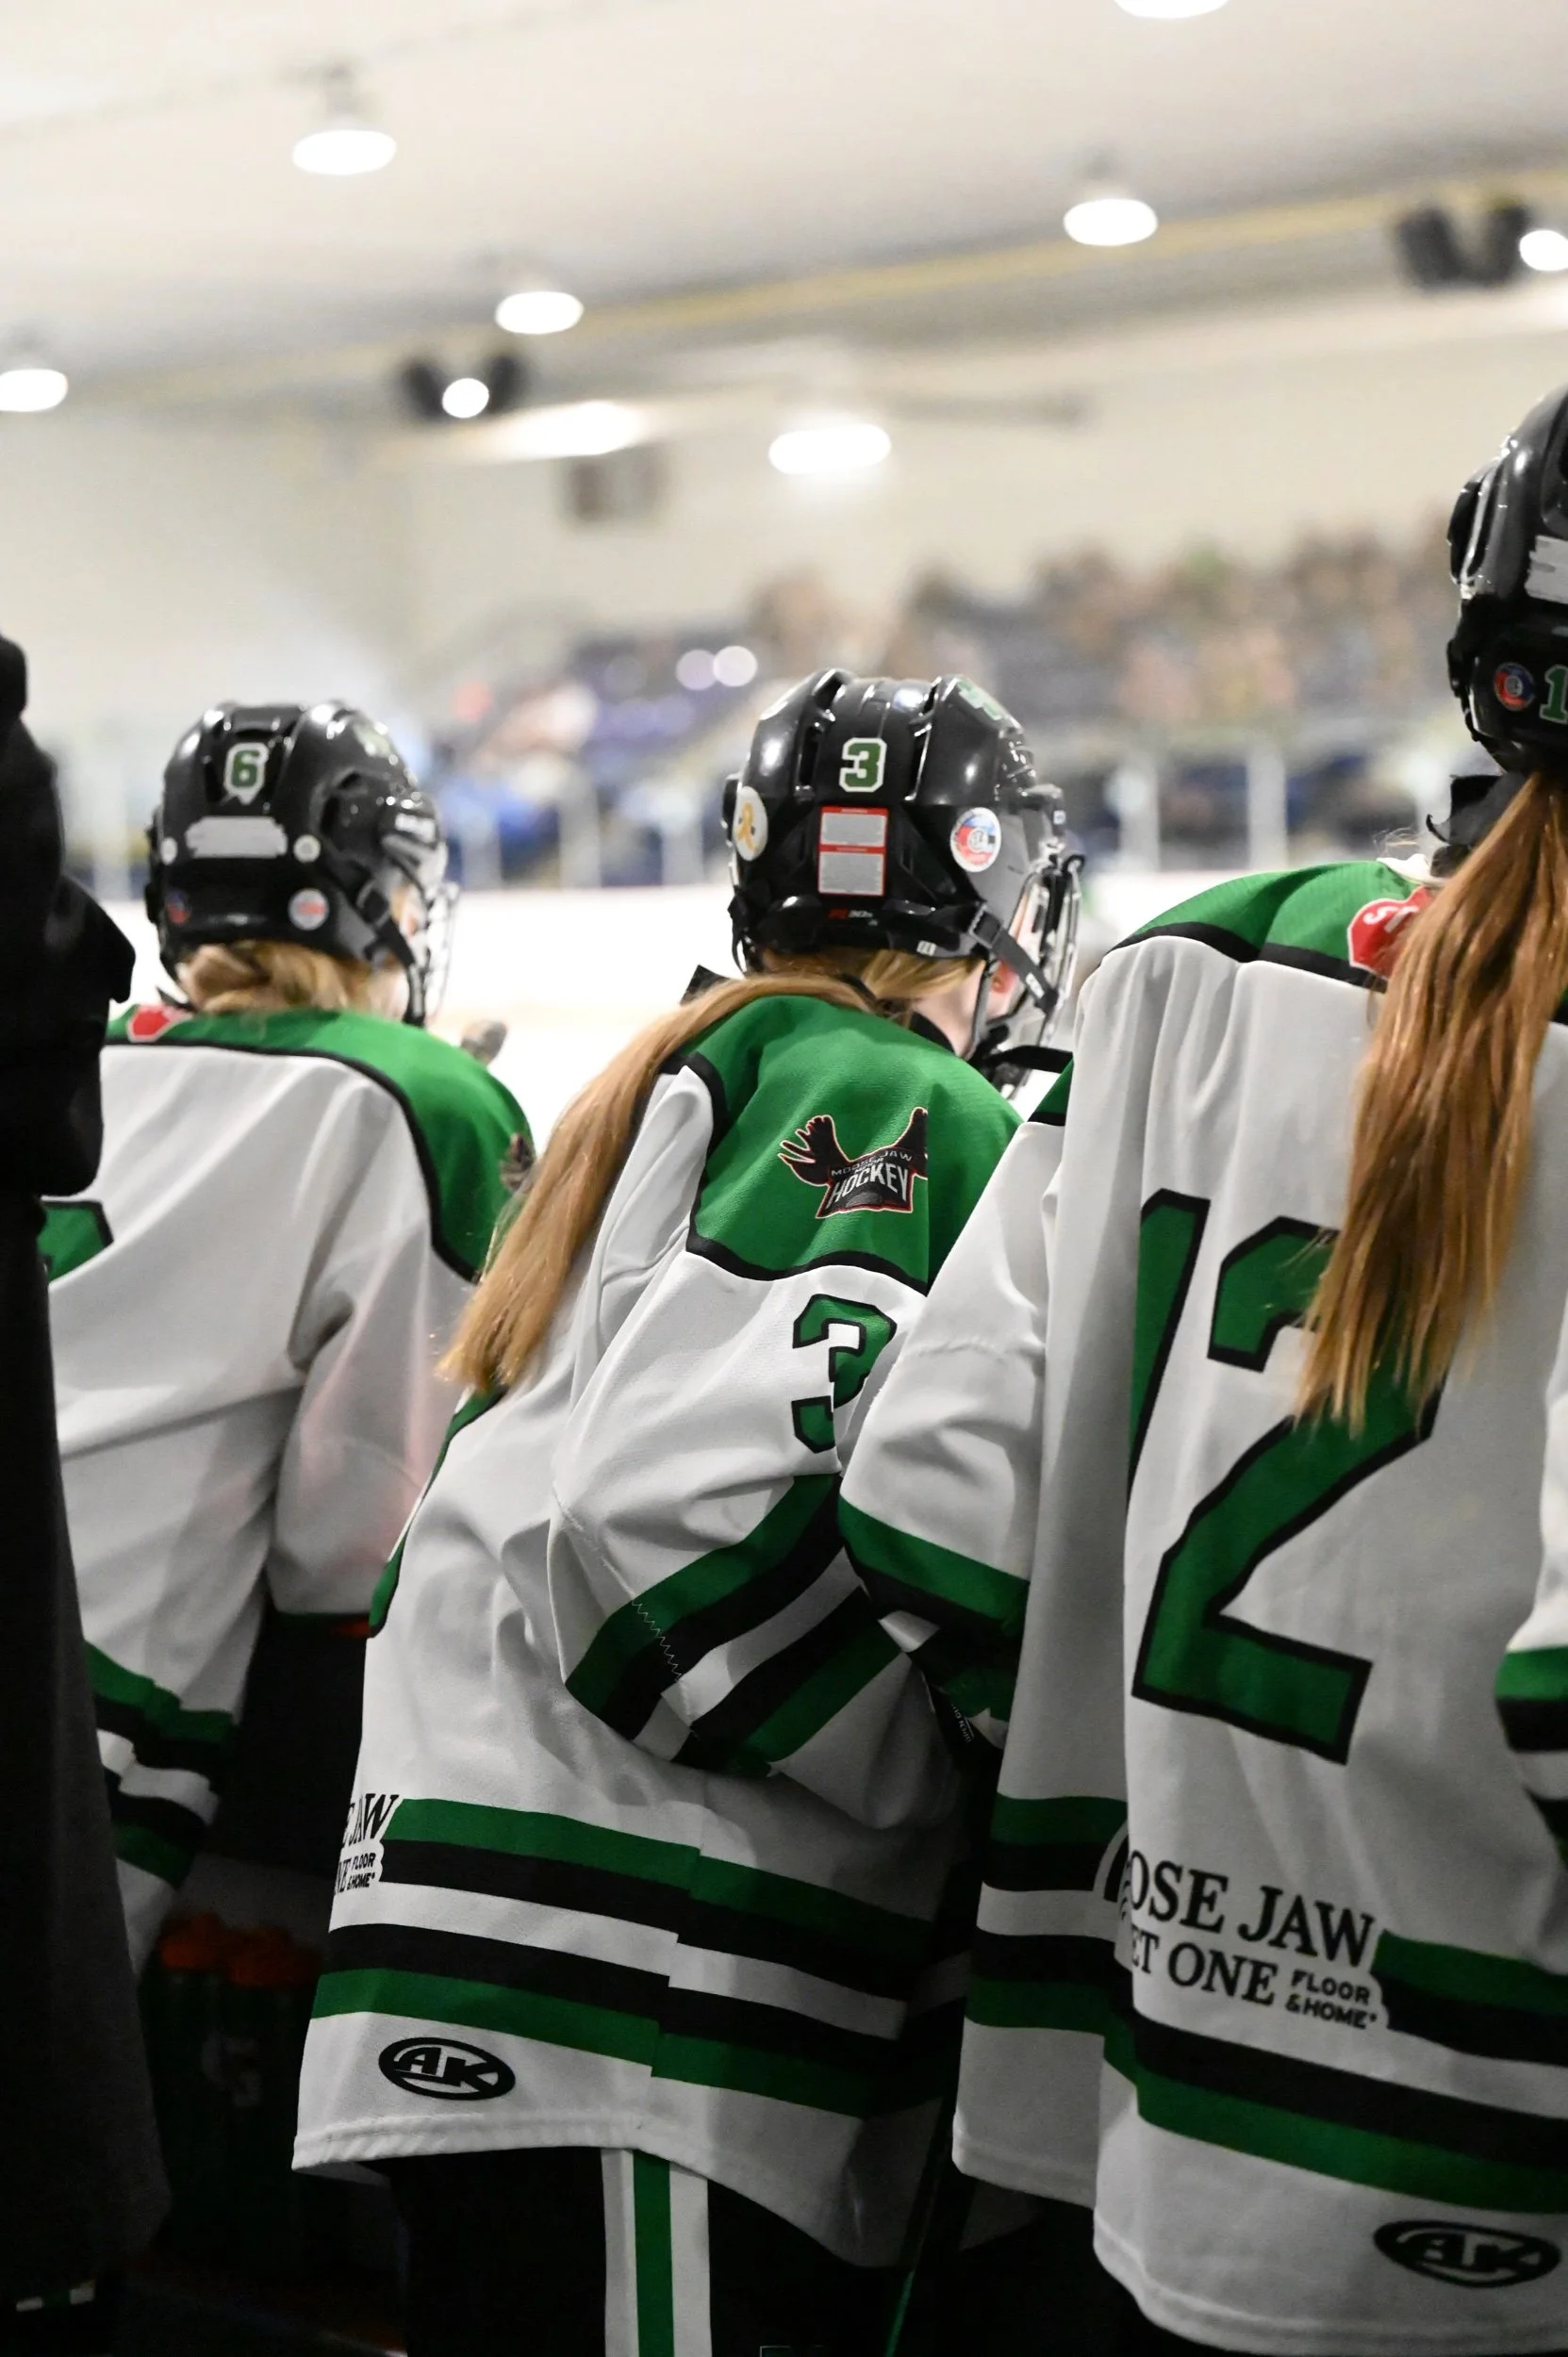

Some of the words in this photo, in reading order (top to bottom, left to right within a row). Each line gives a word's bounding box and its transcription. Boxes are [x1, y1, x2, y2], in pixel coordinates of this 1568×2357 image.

[226, 745, 267, 795] 6
[839, 737, 887, 792] 3
[826, 1162, 908, 1209] HOCKEY
[791, 1294, 898, 1454] 3
[1127, 1187, 1449, 1765] 12
[351, 1853, 376, 1871] FLOOR
[1131, 1849, 1229, 1934] OSE
[1237, 1886, 1376, 1969] JAW
[1168, 1942, 1279, 2007] ONE
[1291, 1968, 1370, 2006] FLOOR
[385, 2040, 510, 2097] AK
